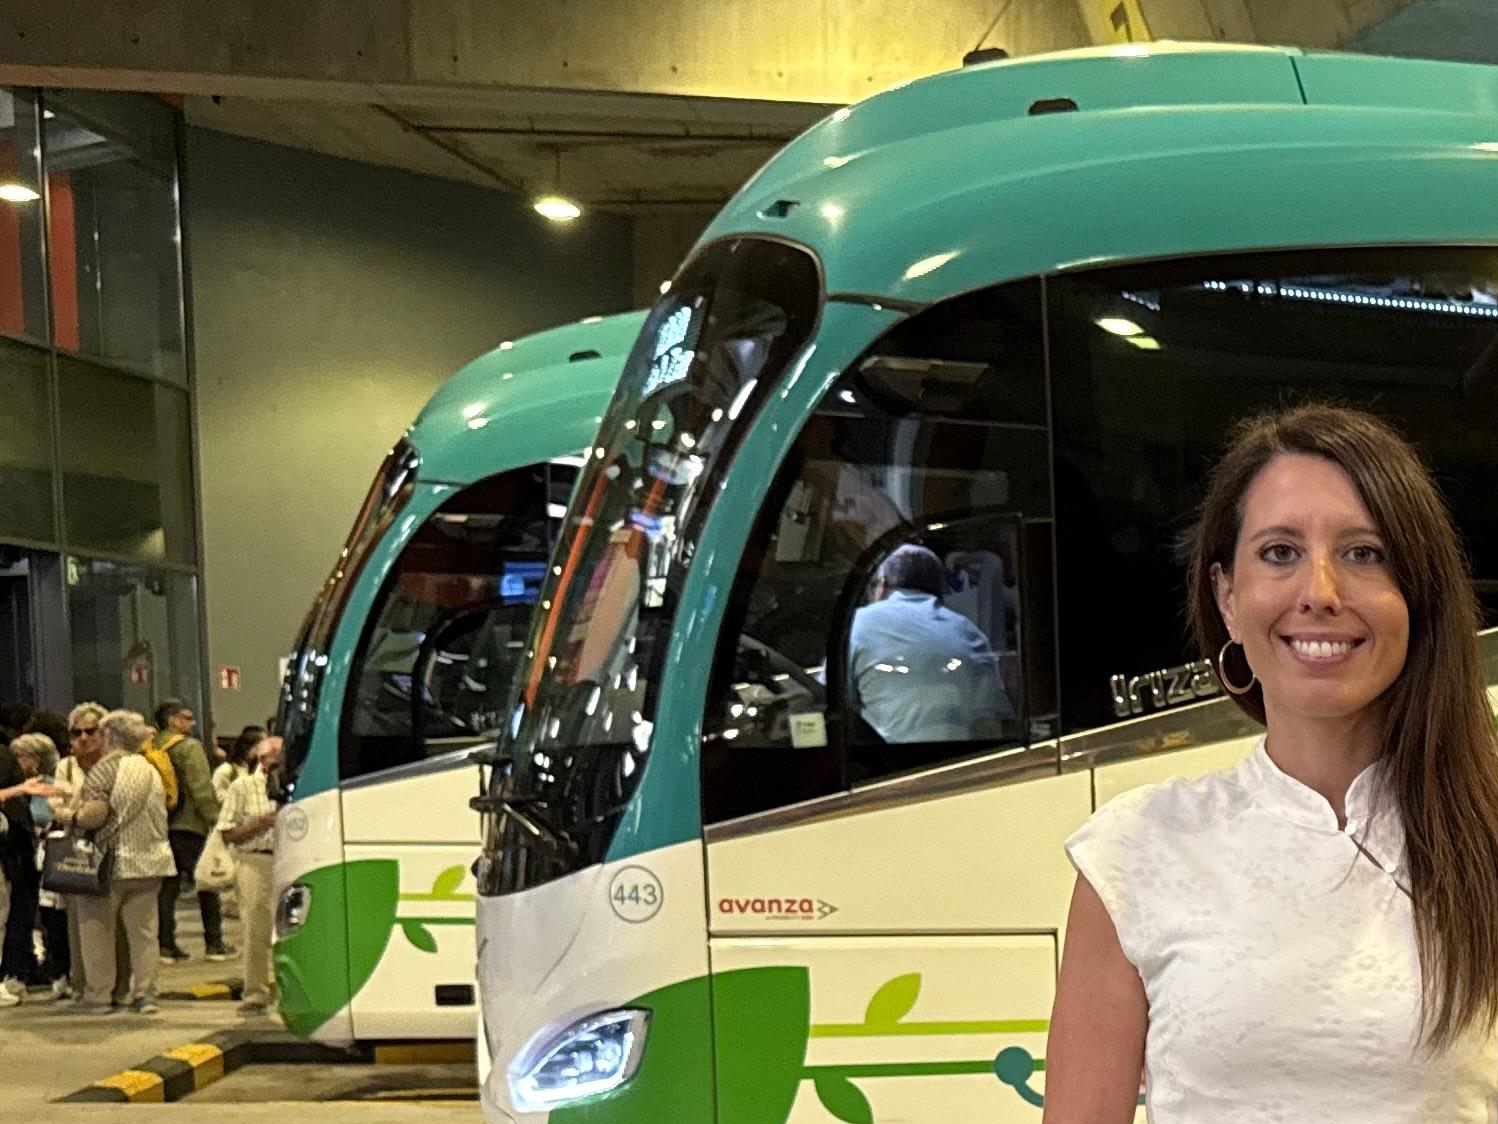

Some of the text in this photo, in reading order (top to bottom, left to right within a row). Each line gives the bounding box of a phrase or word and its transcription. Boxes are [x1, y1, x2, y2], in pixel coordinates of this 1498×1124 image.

[1110, 658, 1219, 717] iriza
[613, 883, 657, 905] 443
[719, 898, 813, 914] avanza
